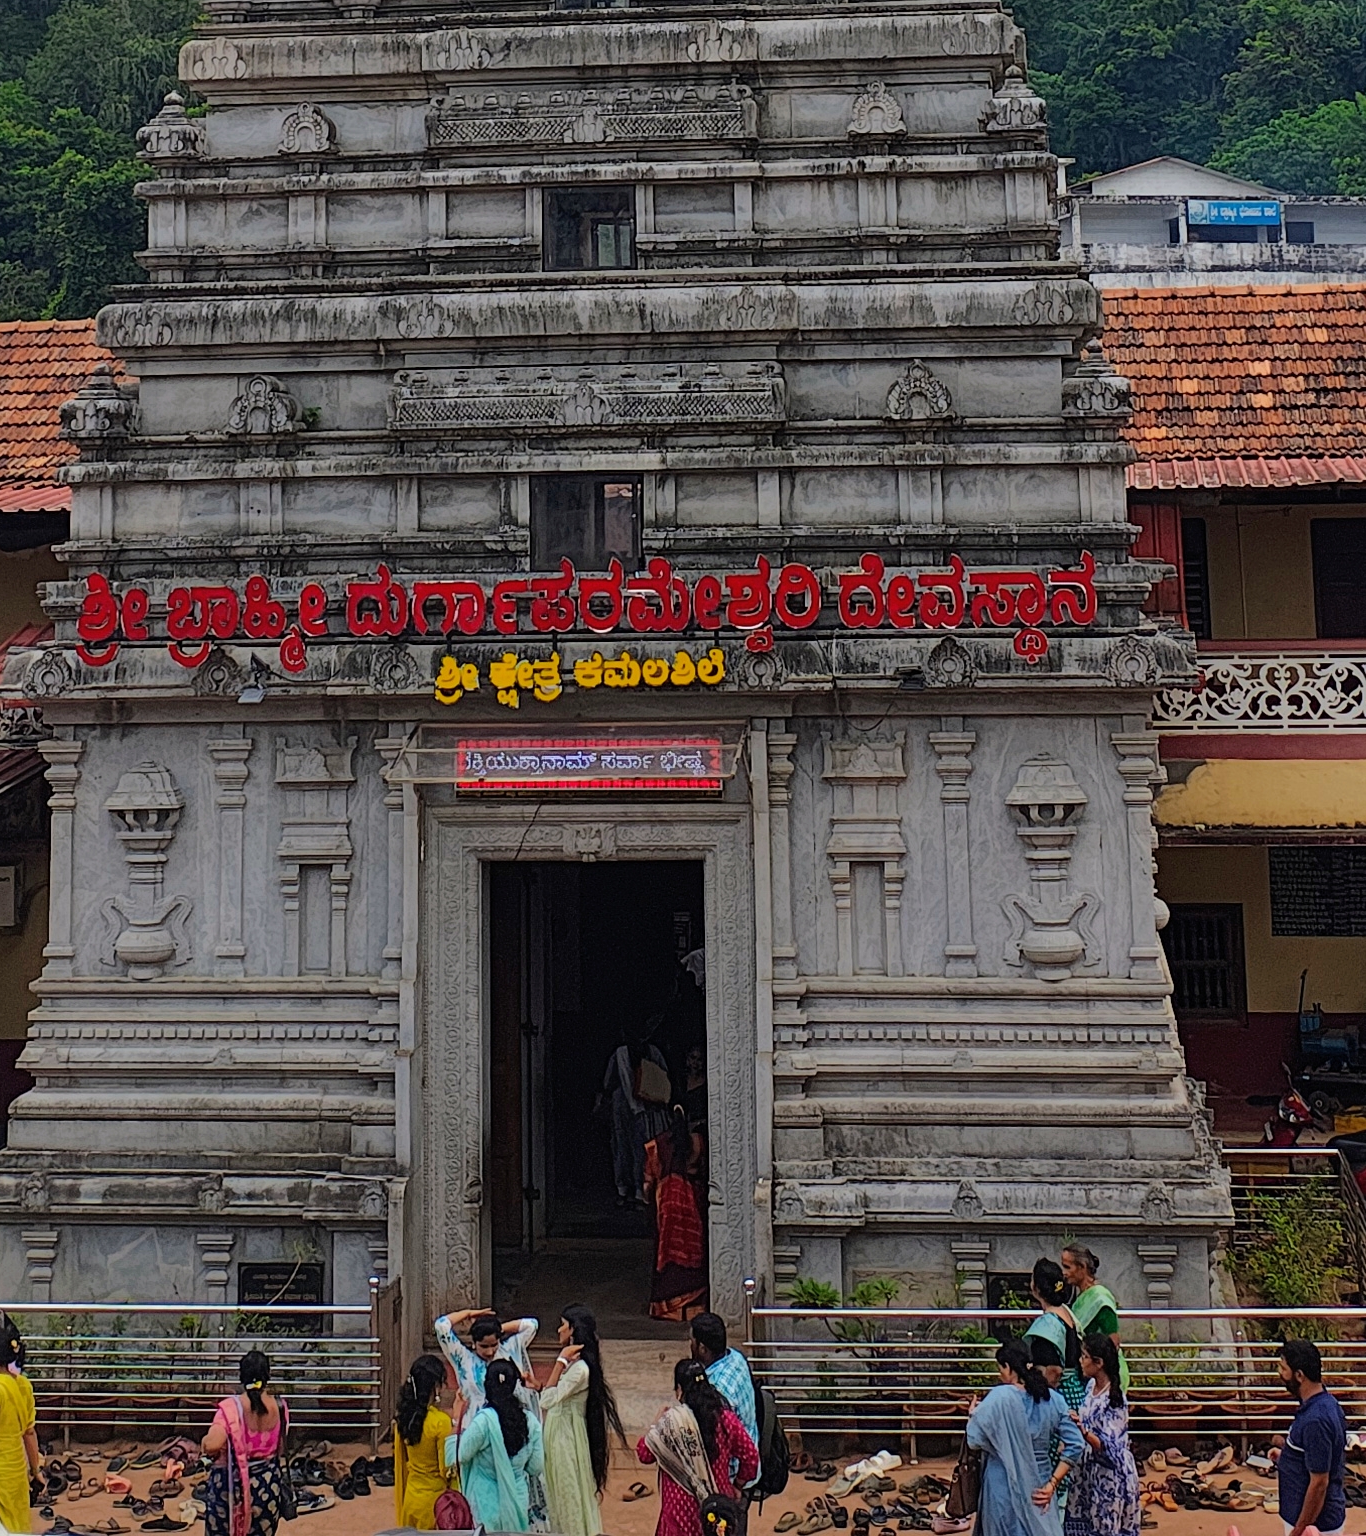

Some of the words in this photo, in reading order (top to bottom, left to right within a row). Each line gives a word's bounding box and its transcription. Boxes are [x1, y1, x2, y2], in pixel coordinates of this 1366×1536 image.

[76, 572, 149, 667] ಶ್ರೀ
[345, 553, 822, 653] ದುರ್ಗಾಪರಮೇಶ್ವರಿ
[838, 550, 1097, 664] ದೇವಸ್ಥಾನ
[435, 651, 480, 705] ಶ್ರೀ
[489, 651, 562, 709] ಕ್ಷೇತ್ರ
[574, 648, 726, 689] ಕಮಲಶಿಲೆ
